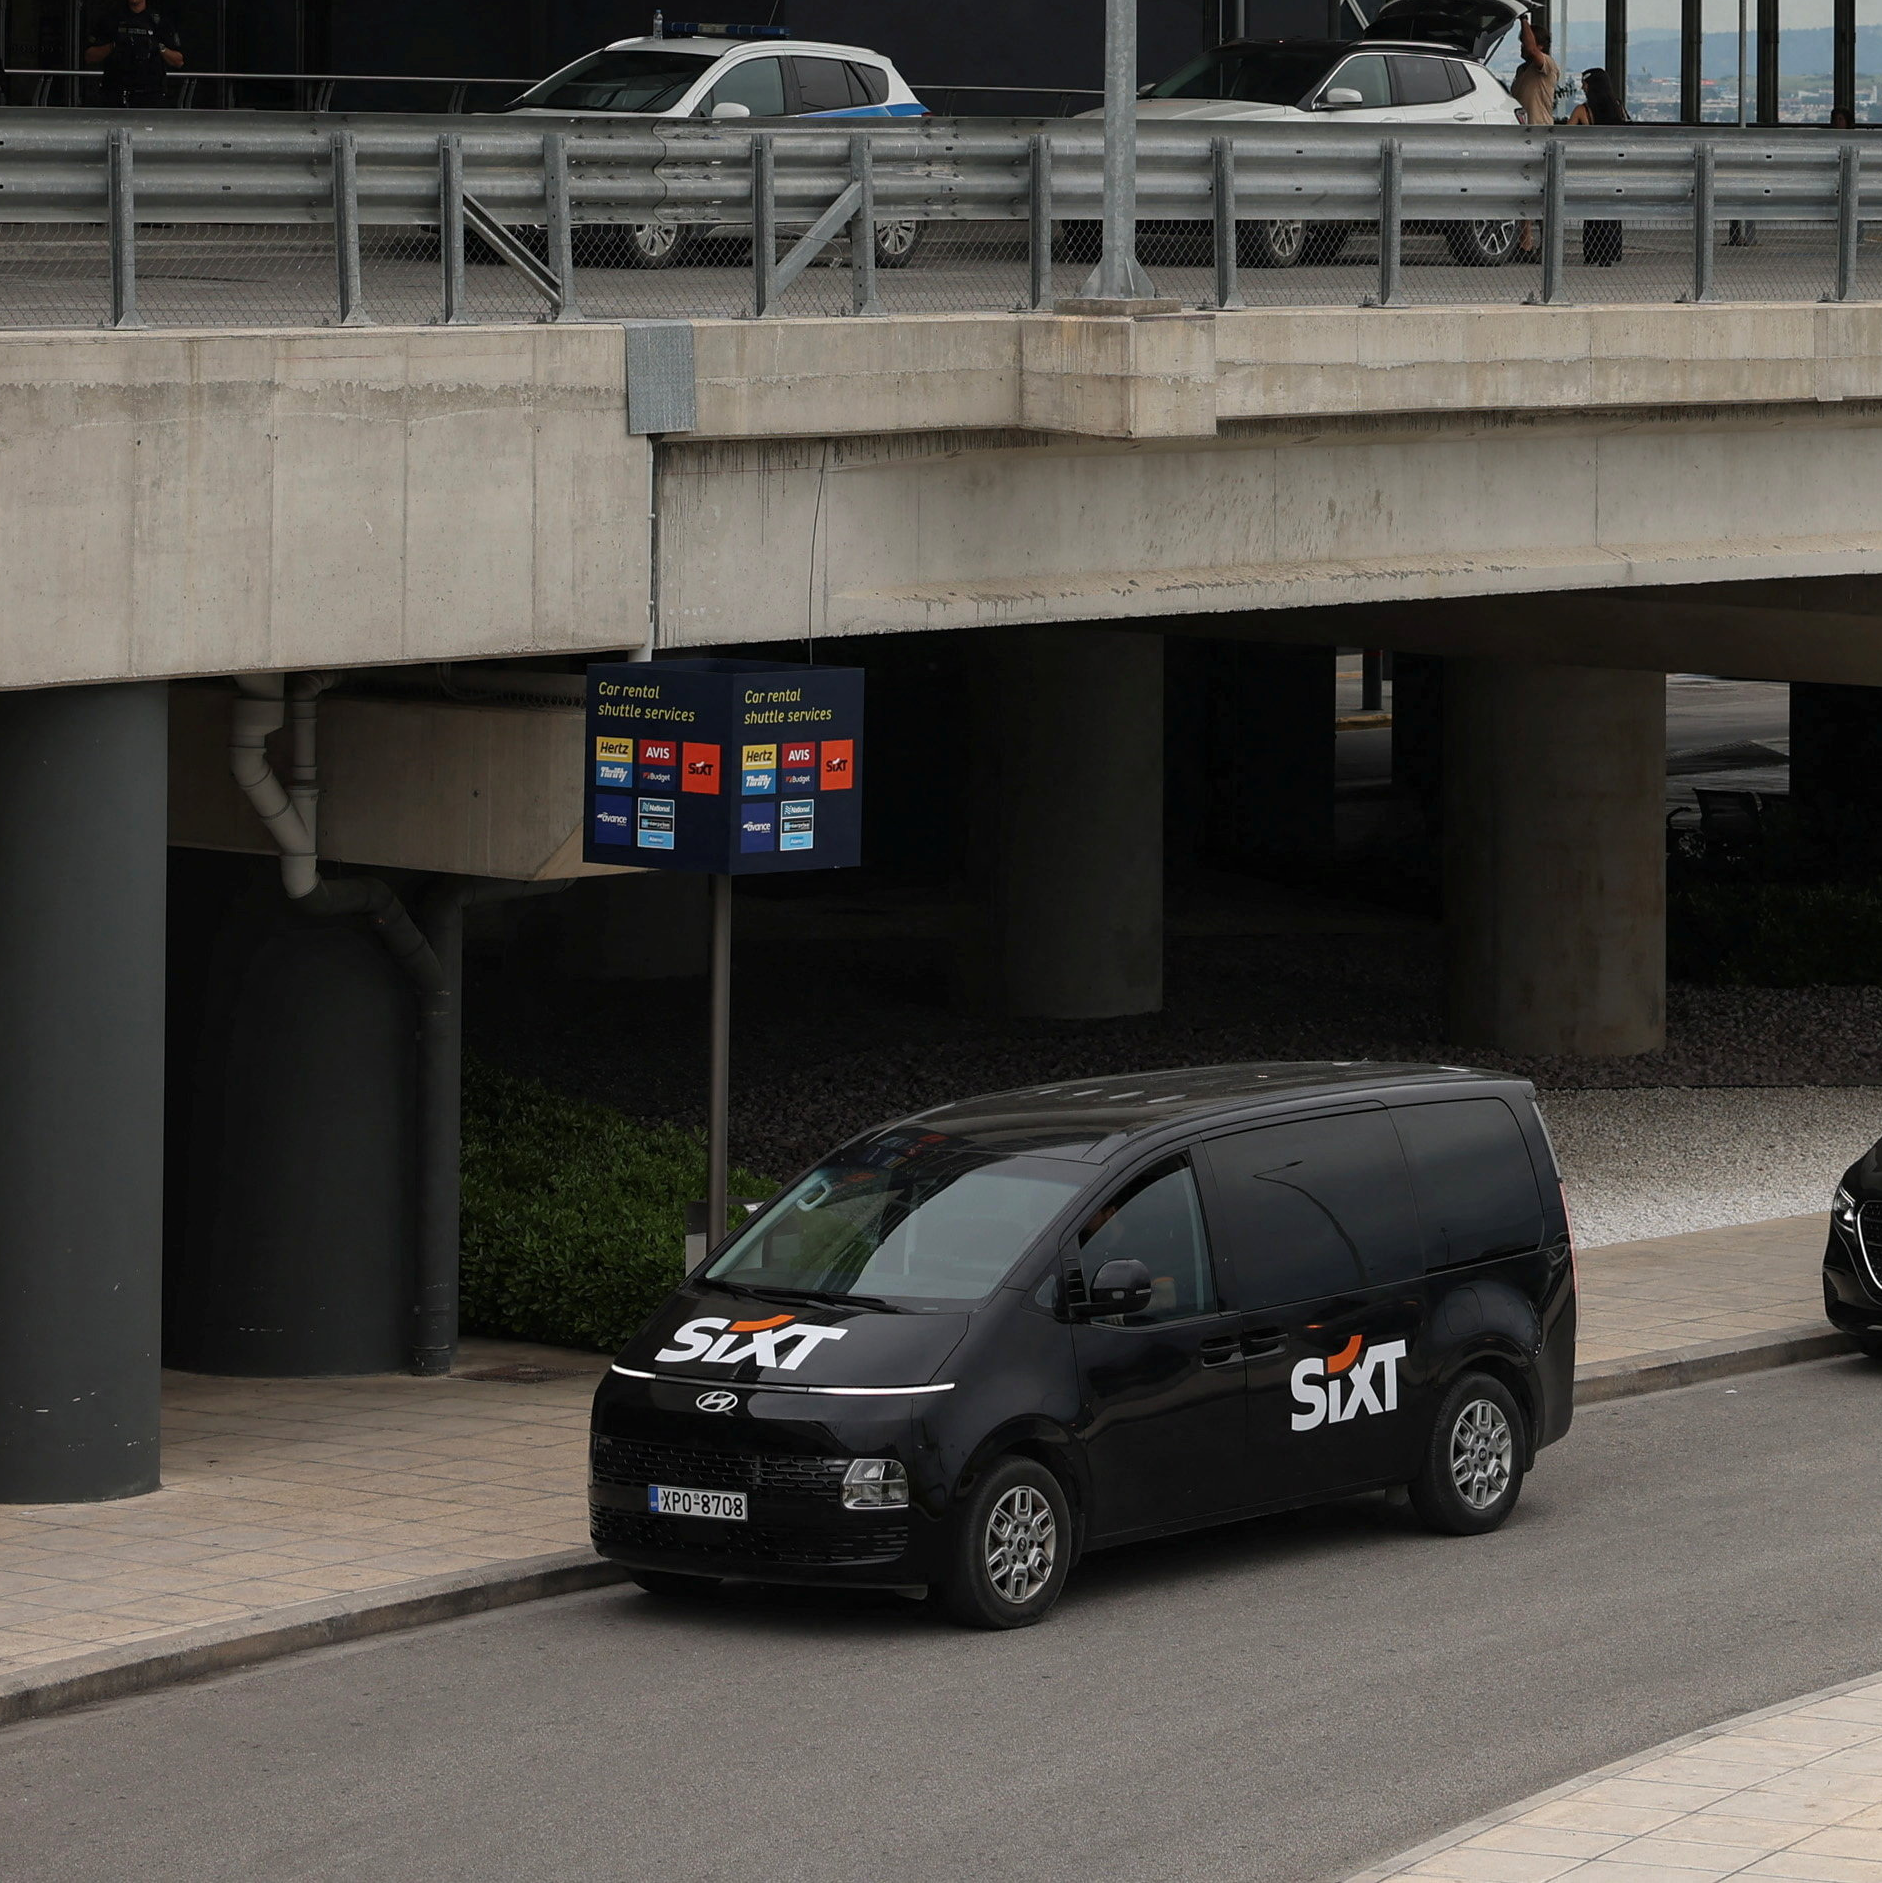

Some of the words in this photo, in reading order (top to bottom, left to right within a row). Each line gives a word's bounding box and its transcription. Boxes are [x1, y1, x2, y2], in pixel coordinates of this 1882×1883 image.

[598, 681, 620, 696] Car
[623, 685, 660, 699] rental
[744, 690, 765, 704] Car
[767, 688, 801, 703] rental
[598, 702, 641, 718] shuttle
[644, 706, 695, 722] services
[744, 709, 785, 725] shuttle
[787, 707, 832, 722] services
[600, 741, 629, 755] Hertz
[646, 746, 670, 759] AVIS
[788, 749, 810, 761] AVIS
[746, 750, 773, 763] Hertz
[649, 772, 671, 783] Budget
[791, 775, 811, 784] Budget
[602, 813, 628, 824] avance
[747, 822, 771, 831] avance
[654, 1314, 849, 1371] SIXT
[1291, 1334, 1406, 1432] SIXT
[662, 1490, 744, 1517] XPO-8708
